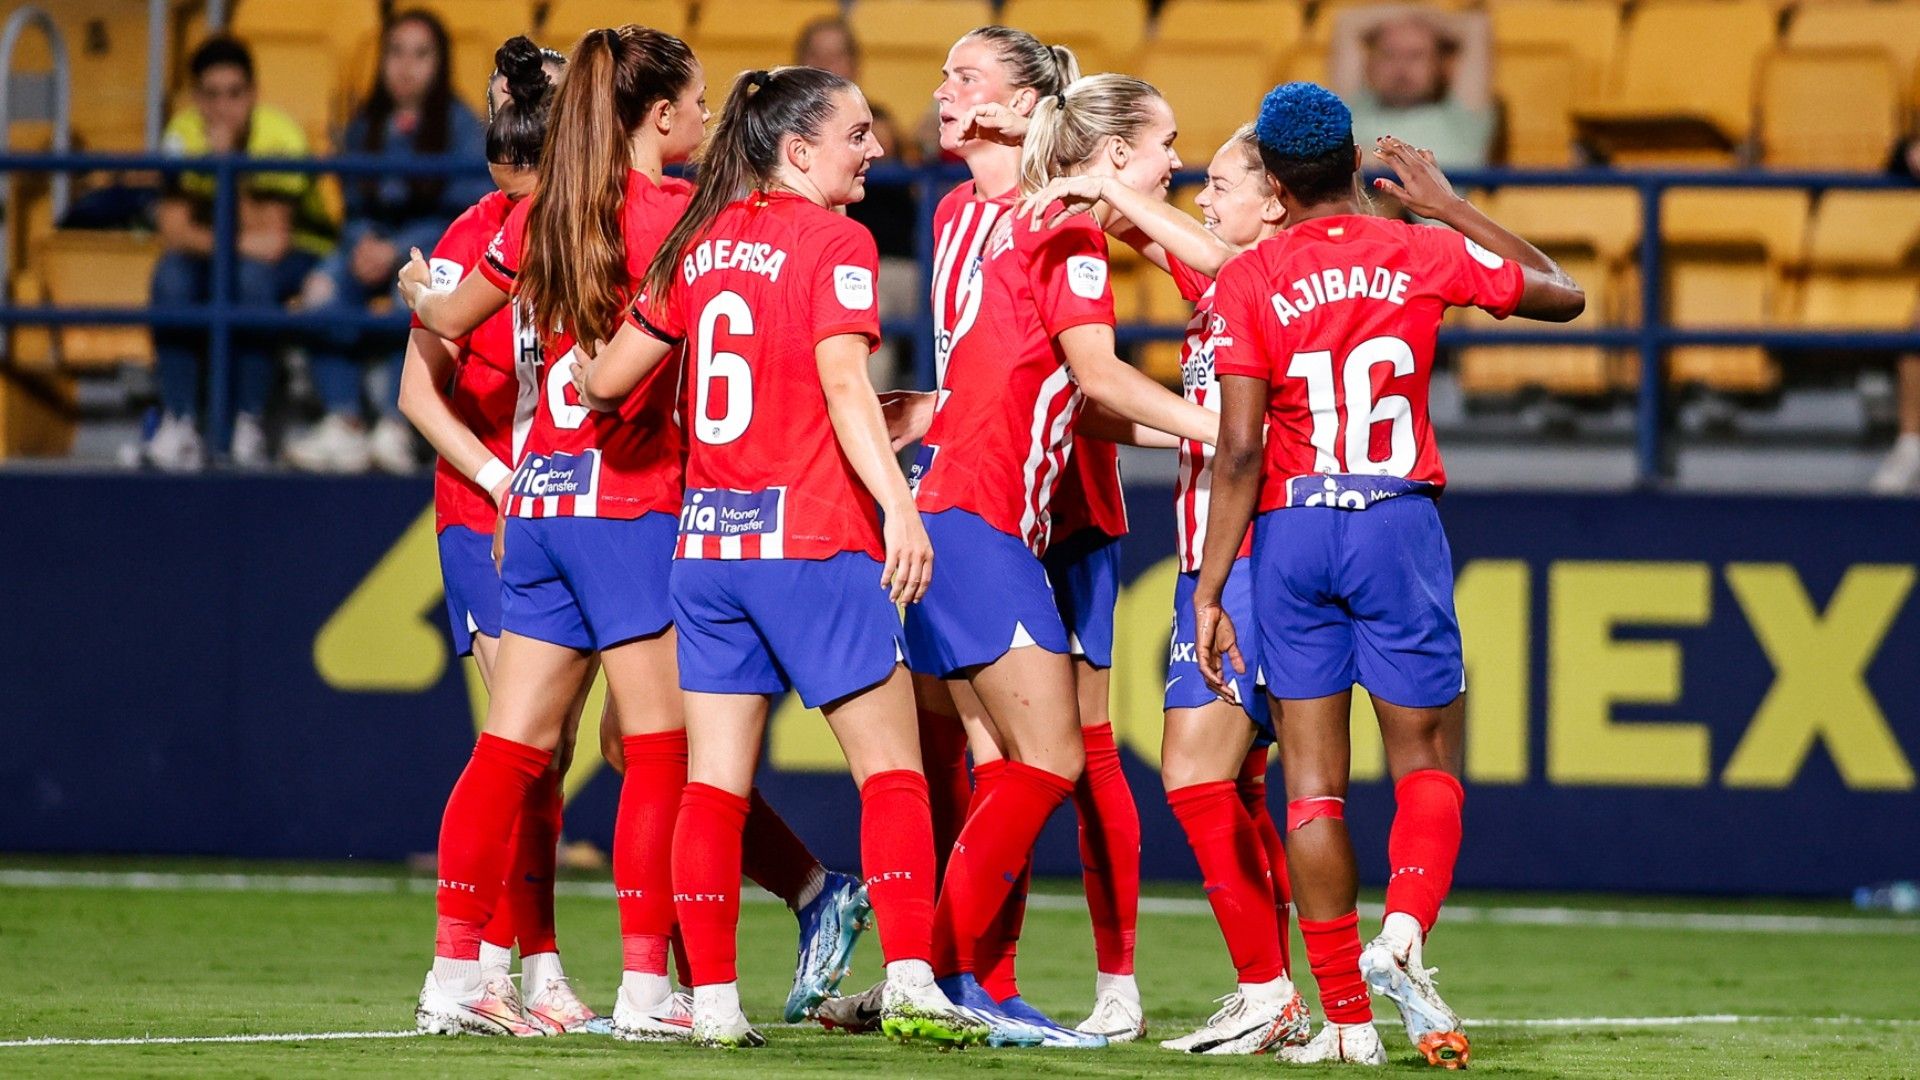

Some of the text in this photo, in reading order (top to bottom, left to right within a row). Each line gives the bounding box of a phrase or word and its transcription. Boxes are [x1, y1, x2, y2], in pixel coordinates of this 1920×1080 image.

[1270, 266, 1412, 327] AJIBADE
[695, 290, 754, 445] 6
[1286, 336, 1416, 478] 16
[514, 458, 550, 495] ria
[545, 480, 579, 493] ransfer
[679, 493, 716, 532] ria
[719, 519, 764, 534] Transfer
[721, 506, 760, 520] Money
[438, 879, 476, 893] TLETI
